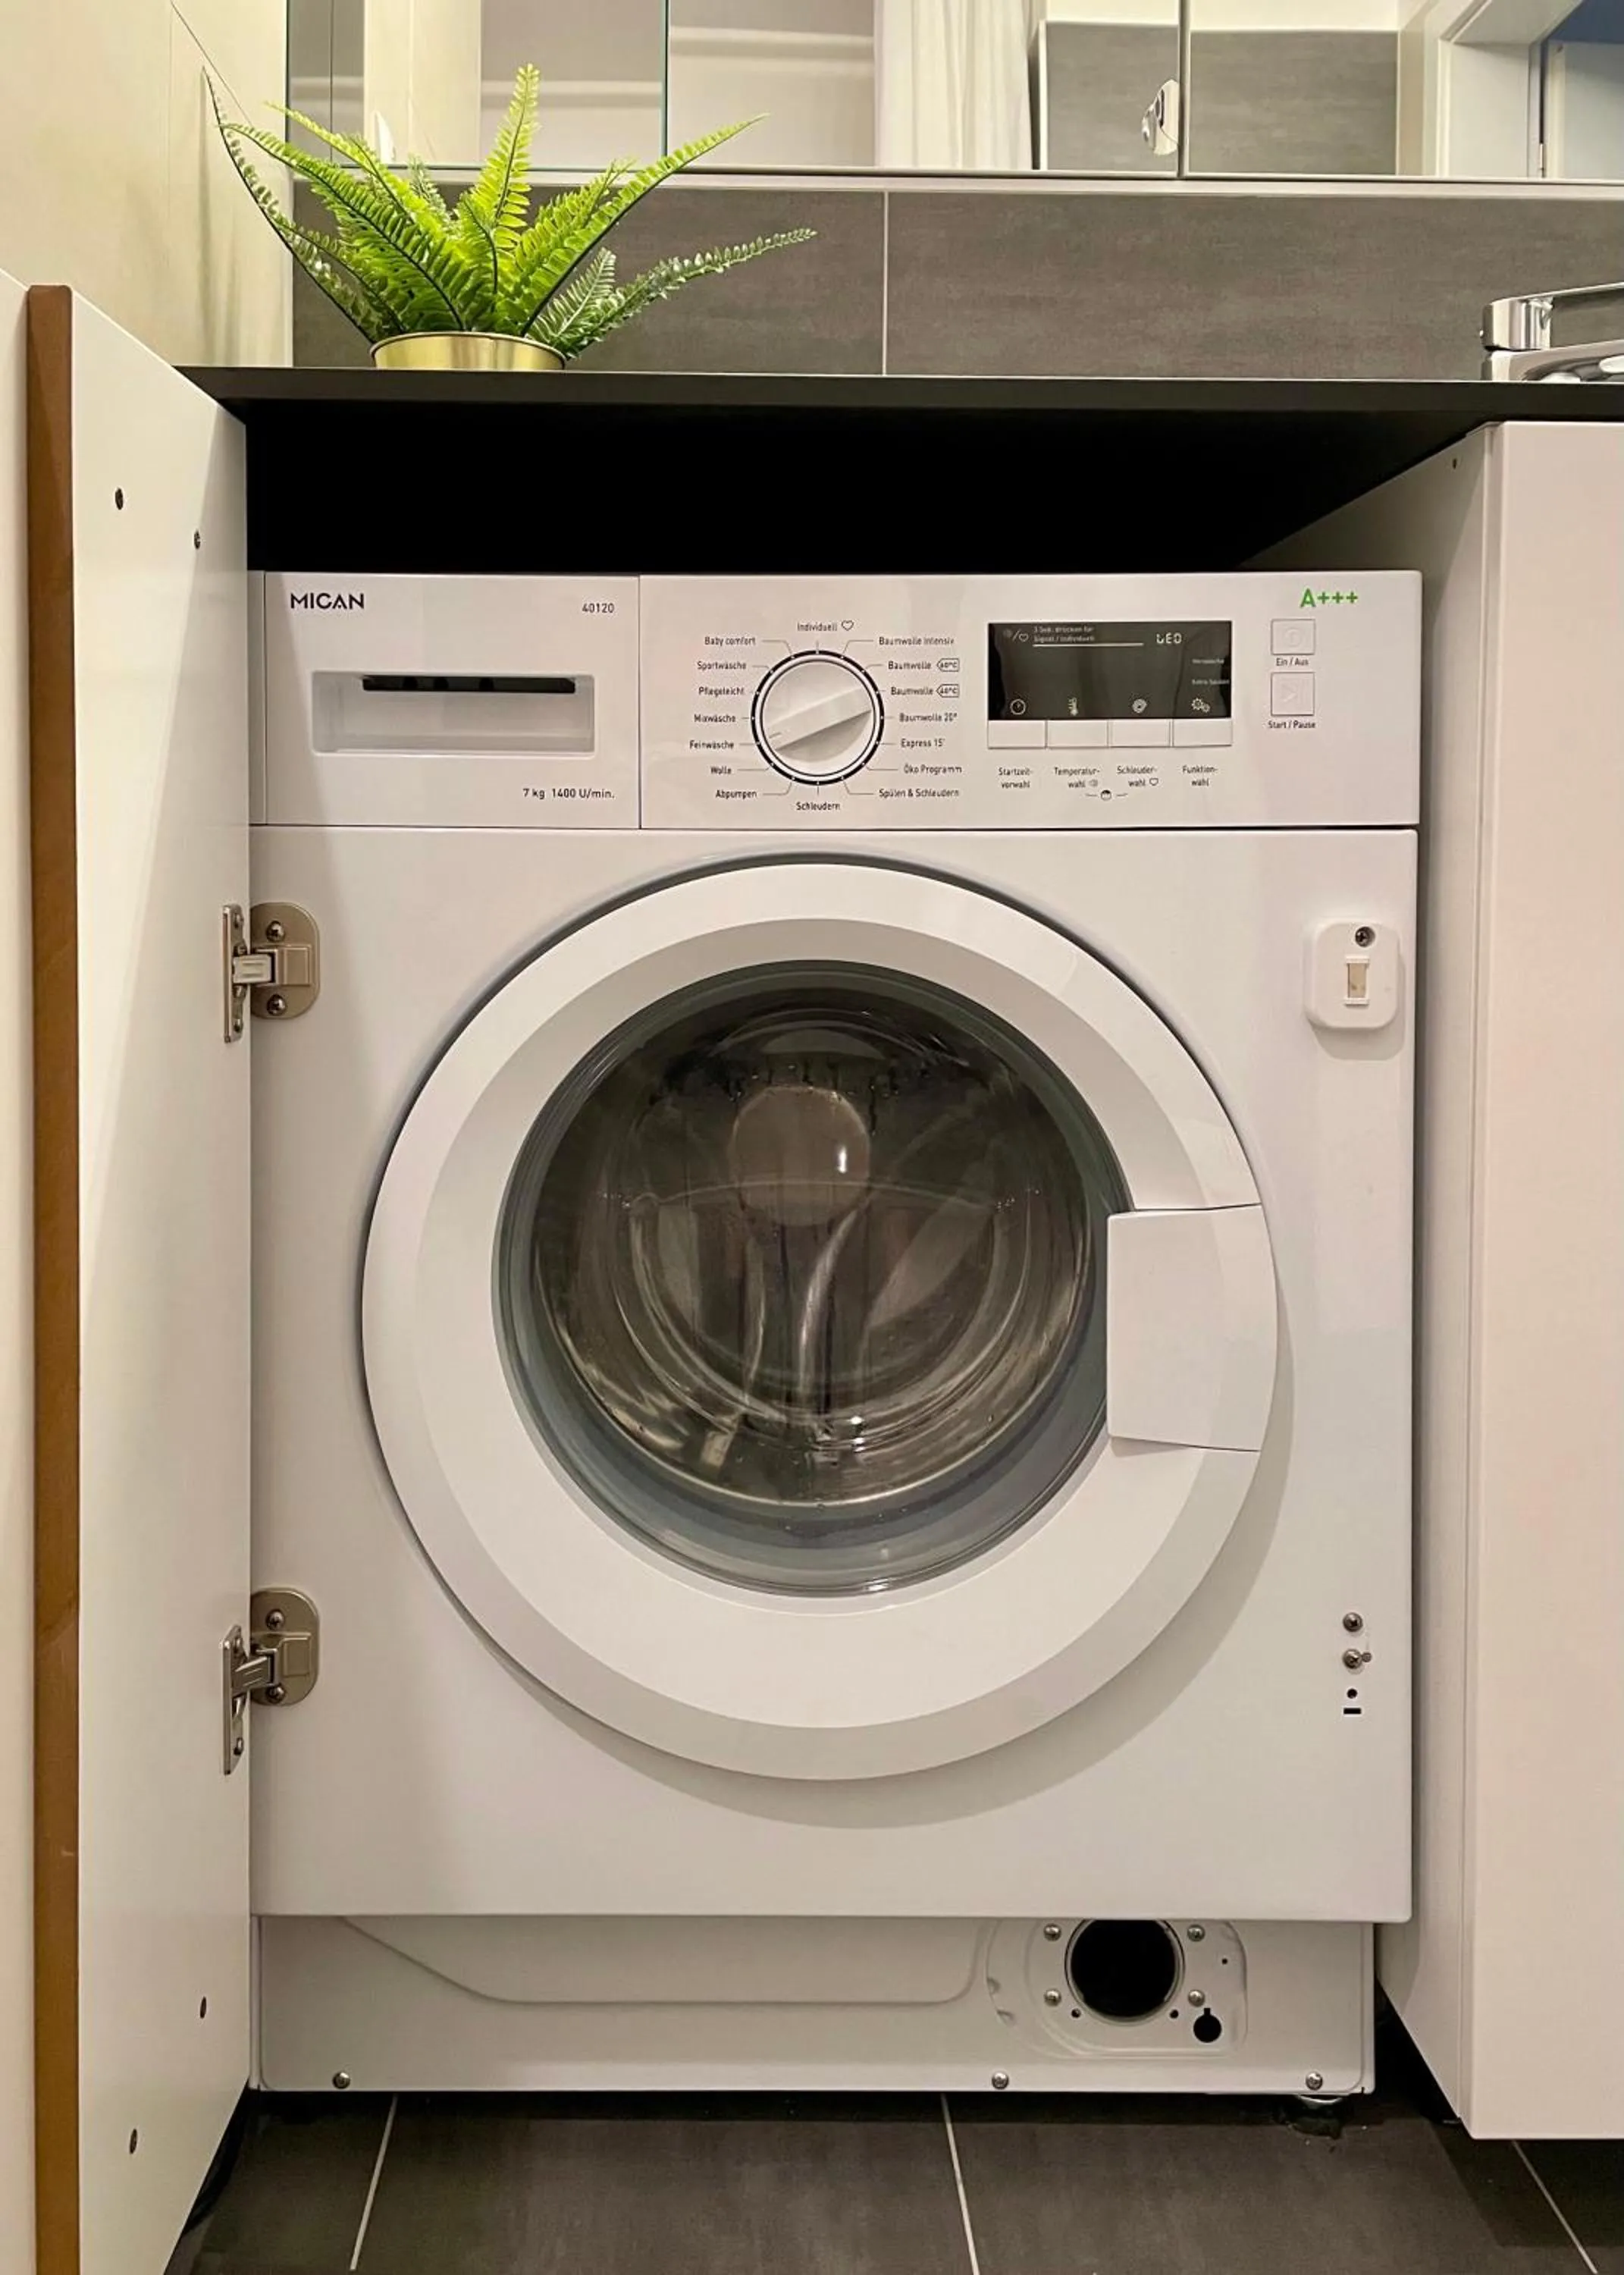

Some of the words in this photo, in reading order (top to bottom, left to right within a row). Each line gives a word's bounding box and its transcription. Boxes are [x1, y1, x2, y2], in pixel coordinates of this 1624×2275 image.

[290, 592, 365, 610] MICAN
[1300, 588, 1359, 608] A+++
[582, 601, 615, 615] 40120
[797, 623, 838, 632] Individuell
[704, 635, 723, 646] Baby
[725, 635, 756, 645] comfort
[879, 636, 922, 645] Baumwolle
[888, 661, 932, 670] Baumwolle
[1276, 657, 1287, 667] Ein
[1288, 657, 1293, 667] /
[1294, 657, 1309, 666] Aus
[698, 687, 745, 698] Pflegeleicht
[891, 686, 933, 695] Baumwolle
[899, 713, 942, 723] Baumwolle
[1268, 720, 1287, 729] Start
[1293, 720, 1315, 729] Pause
[901, 738, 932, 748] Express
[710, 766, 732, 775] Wolle
[904, 762, 920, 774] Öko
[920, 764, 962, 775] Programm
[1001, 780, 1030, 789] vorwahl
[1068, 780, 1086, 788] wahl
[1128, 779, 1146, 787] wahl
[1191, 778, 1209, 786] wahl
[522, 788, 529, 799] 7
[531, 788, 545, 801] kg
[550, 788, 577, 799] 1400
[578, 788, 616, 800] U/min.
[715, 789, 757, 799] Abpumpen
[879, 789, 906, 799] Spülen
[908, 789, 914, 797] &
[915, 789, 959, 797] Schleudern
[795, 801, 841, 811] Schleudern
